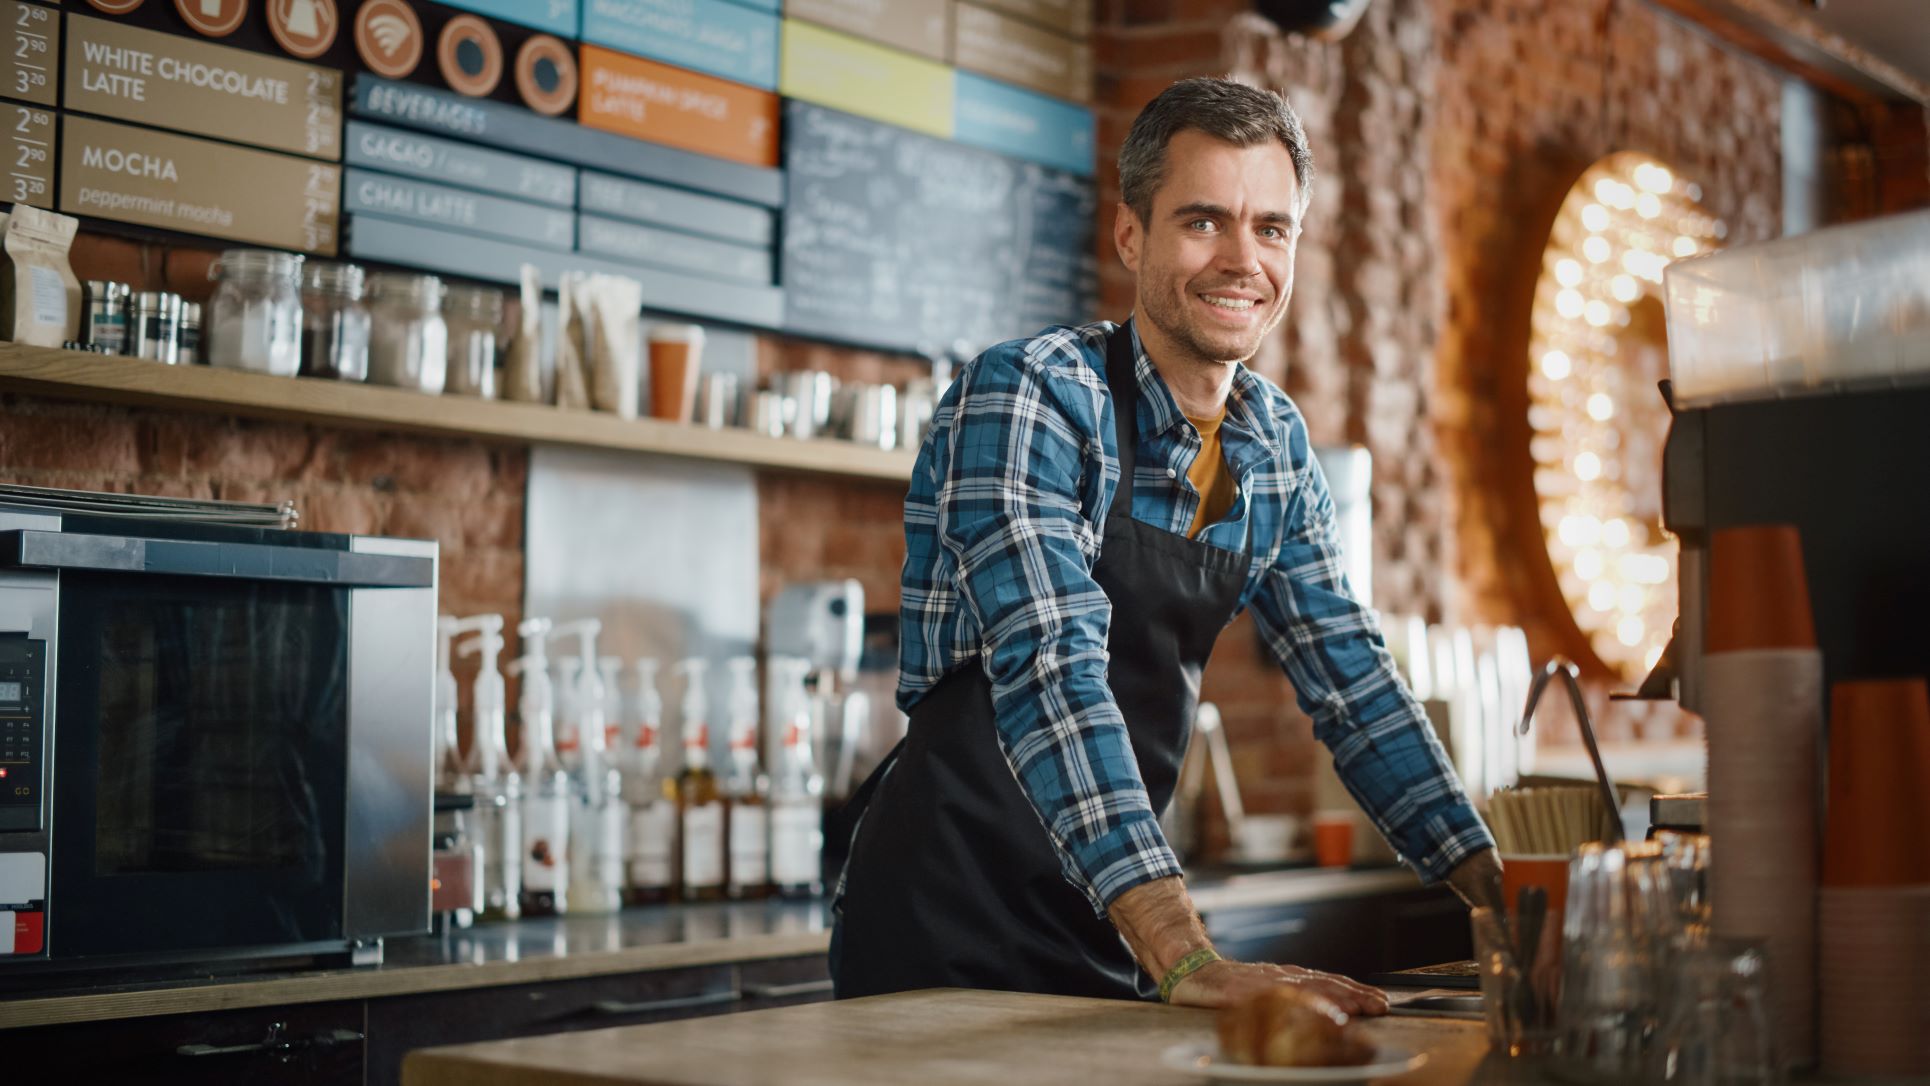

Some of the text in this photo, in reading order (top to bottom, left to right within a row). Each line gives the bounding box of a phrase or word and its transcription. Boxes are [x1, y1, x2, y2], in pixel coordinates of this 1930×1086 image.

[82, 68, 146, 102] LATTE
[83, 41, 153, 77] WHITE
[157, 57, 289, 105] CHOCOLATE
[368, 84, 487, 135] BEVERAGES
[82, 145, 178, 183] MOCHA
[360, 132, 434, 169] CACAO
[78, 187, 233, 227] peppermint mocha
[359, 180, 476, 226] CHAI LATTE
